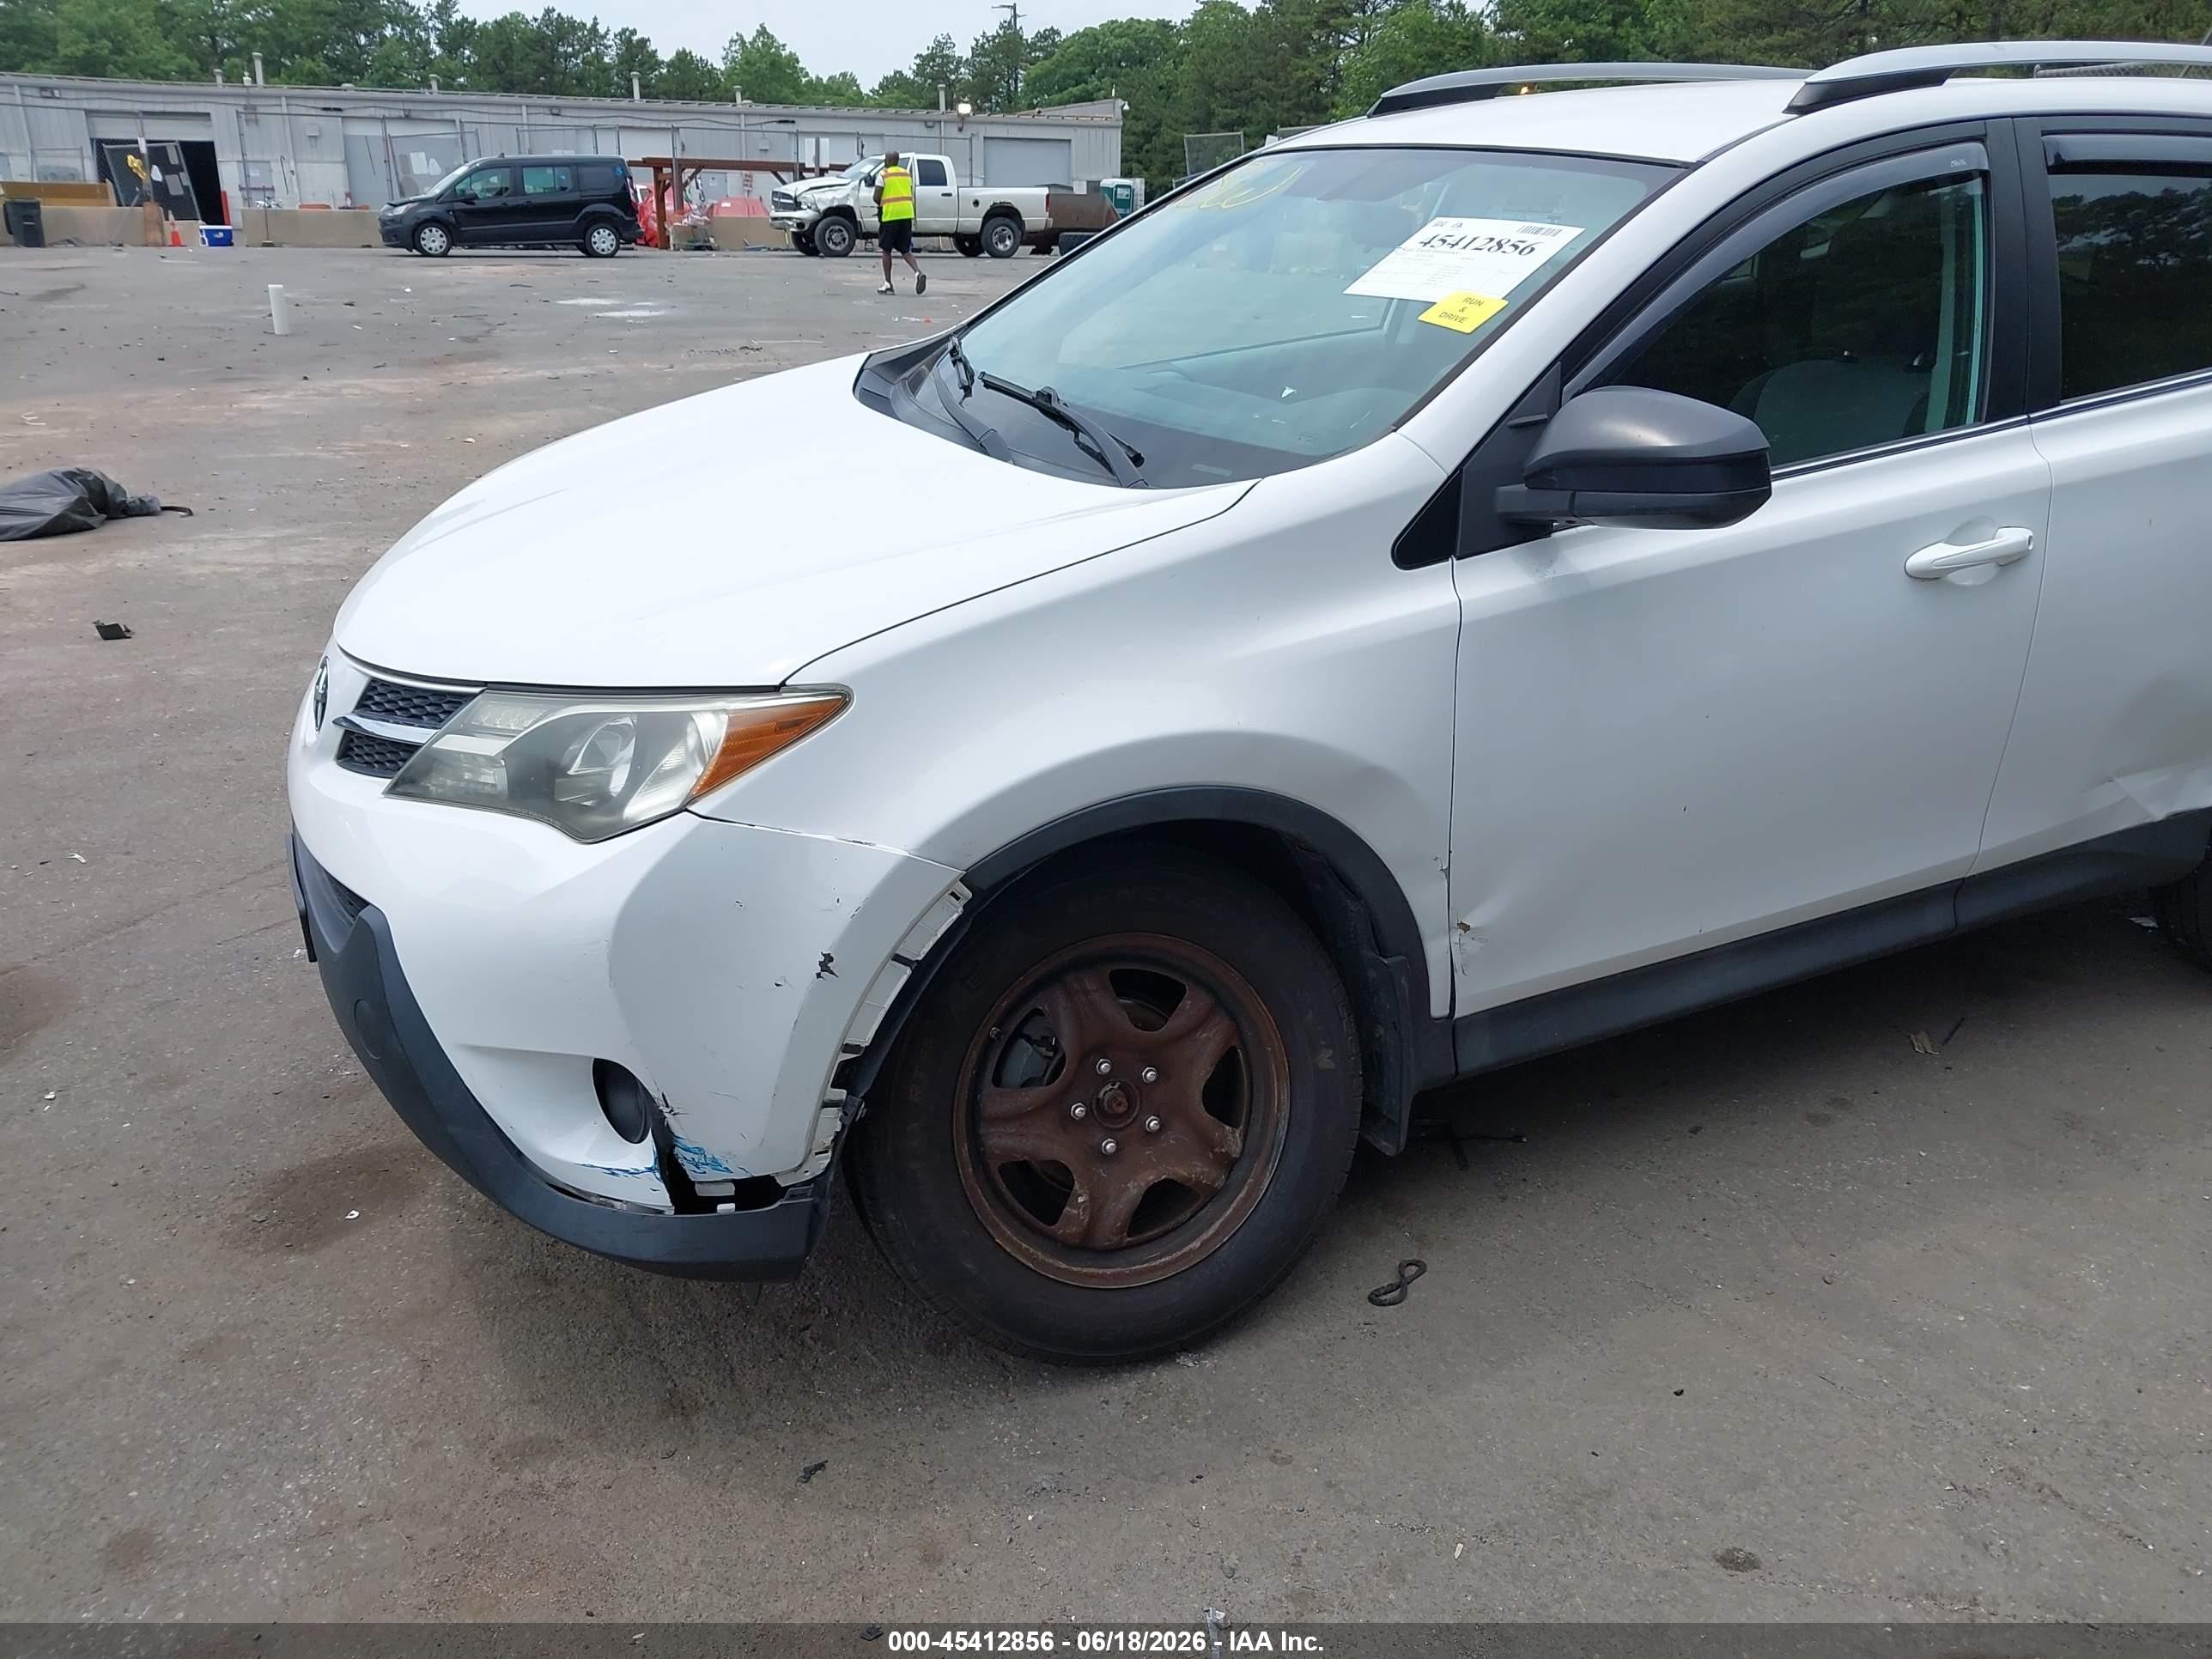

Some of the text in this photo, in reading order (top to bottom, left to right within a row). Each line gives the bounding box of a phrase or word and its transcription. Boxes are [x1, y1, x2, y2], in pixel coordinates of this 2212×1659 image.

[1419, 234, 1546, 256] 45412856
[1462, 297, 1485, 307] RUN
[1438, 312, 1468, 324] DRIVE
